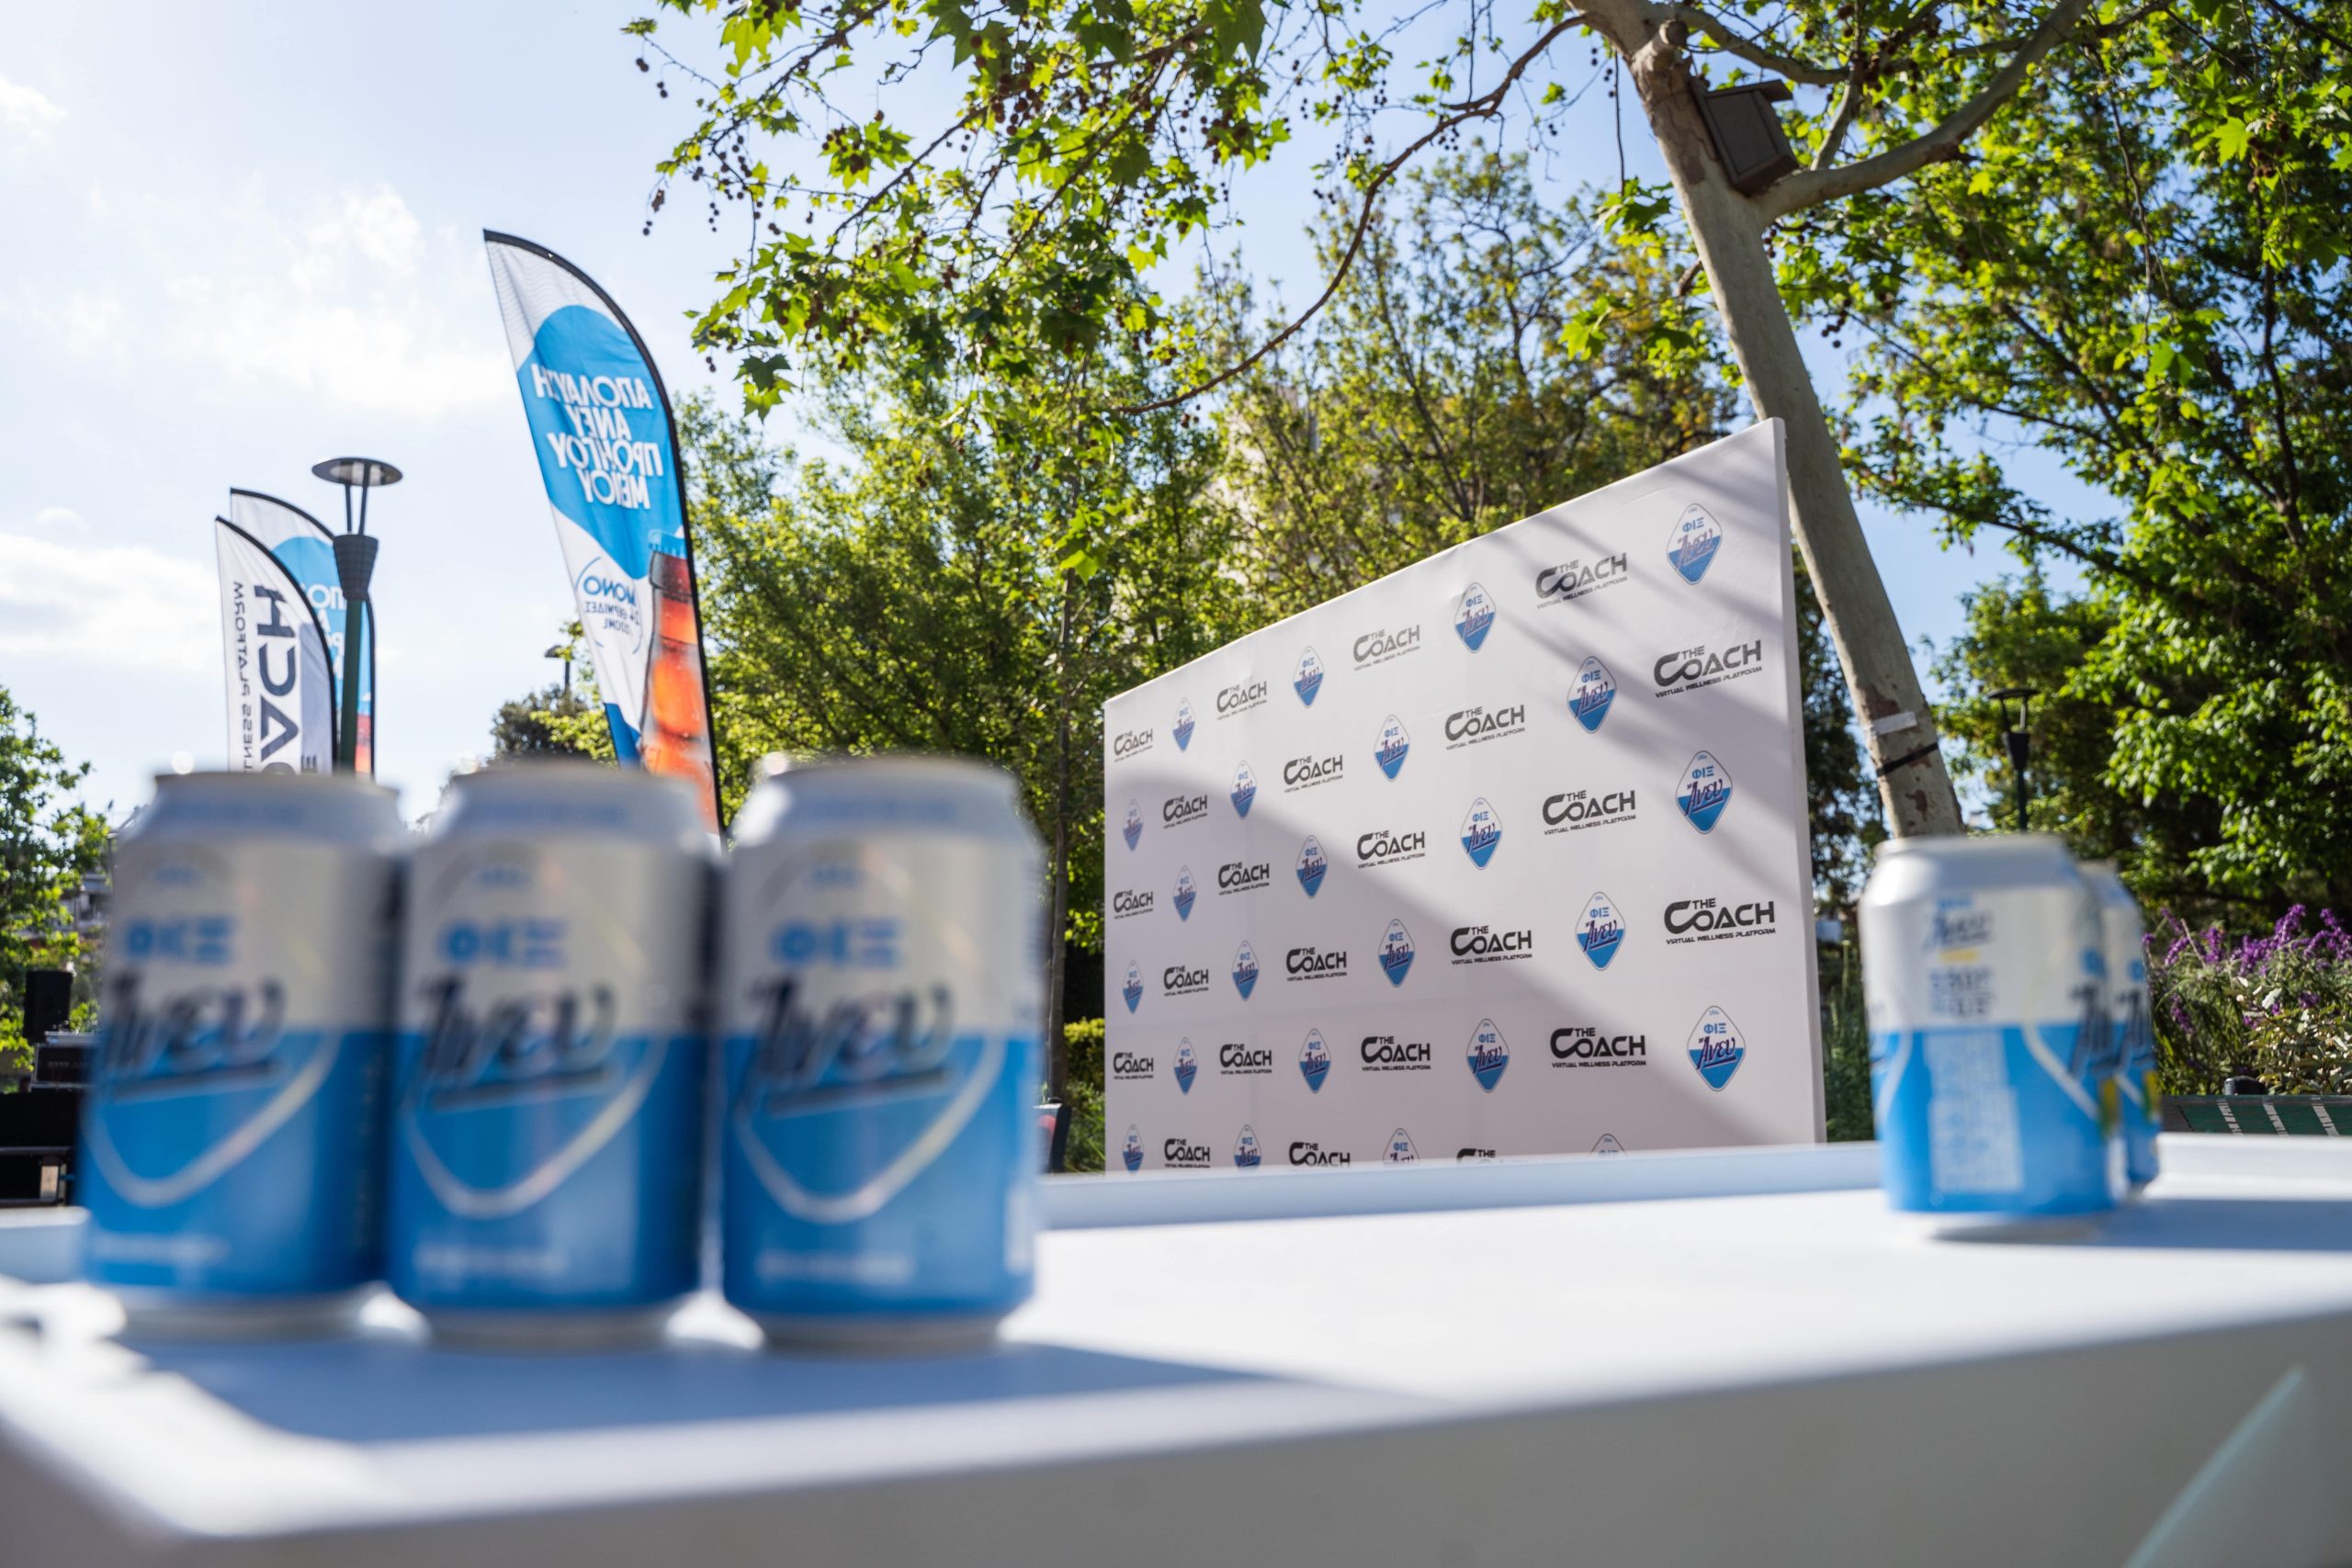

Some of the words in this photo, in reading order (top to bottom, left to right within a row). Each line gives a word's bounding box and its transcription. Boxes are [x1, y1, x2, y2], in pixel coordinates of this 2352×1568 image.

[1682, 516, 1704, 535] ΦΙΞ
[1536, 551, 1626, 600] COACH
[1559, 558, 1579, 575] THE
[1466, 593, 1482, 608] ΦΙΞ
[1353, 624, 1419, 662] COACH
[1370, 627, 1385, 641] THE
[1681, 645, 1705, 661] THE
[1654, 639, 1761, 687] COACH
[1581, 670, 1600, 684] ΦΙΞ
[1656, 686, 1684, 699] VIRTUAL
[1685, 676, 1723, 691] WELLNESS
[1724, 665, 1762, 681] PLATFORM
[1216, 682, 1266, 712] COACH
[1229, 683, 1240, 694] THE
[1465, 705, 1483, 719] THE
[1444, 703, 1524, 741] COACH
[1114, 729, 1152, 755] COACH
[1283, 754, 1342, 784] COACH
[1299, 755, 1312, 766] THE
[1692, 765, 1715, 780] ΦΙΞ
[1566, 789, 1587, 802] THE
[1163, 796, 1207, 821] COACH
[1472, 809, 1488, 822] ΦΙΞ
[1543, 789, 1634, 825] COACH
[1544, 826, 1568, 836] VIRTUAL
[1569, 819, 1601, 831] WELLNESS
[1602, 813, 1635, 825] PLATFORM
[1374, 829, 1389, 840] THE
[1357, 830, 1424, 860] COACH
[1218, 863, 1269, 887] COACH
[1231, 862, 1243, 871] THE
[1114, 891, 1152, 912] COACH
[1691, 897, 1716, 910] THE
[1589, 907, 1610, 919] ΦΙΞ
[1664, 900, 1774, 934] COACH
[1471, 925, 1489, 936] THE
[1666, 936, 1695, 944] VIRTUAL
[1696, 932, 1734, 942] WELLNESS
[1736, 928, 1775, 938] PLATFORM
[1301, 946, 1315, 955] THE
[1450, 927, 1532, 956] COACH
[1285, 948, 1346, 974] COACH
[1163, 966, 1208, 989] COACH
[1574, 1027, 1596, 1037] THE
[1703, 1022, 1726, 1034] ΦΙΞ
[1379, 1035, 1394, 1044] THE
[1478, 1033, 1496, 1043] ΦΙΞ
[1550, 1028, 1645, 1058] COACH
[1219, 1043, 1272, 1067] COACH
[1361, 1036, 1430, 1063] COACH
[1113, 1052, 1153, 1073] COACH
[1164, 1138, 1210, 1162] COACH
[1305, 1142, 1318, 1150] THE
[1477, 1148, 1496, 1157] THE
